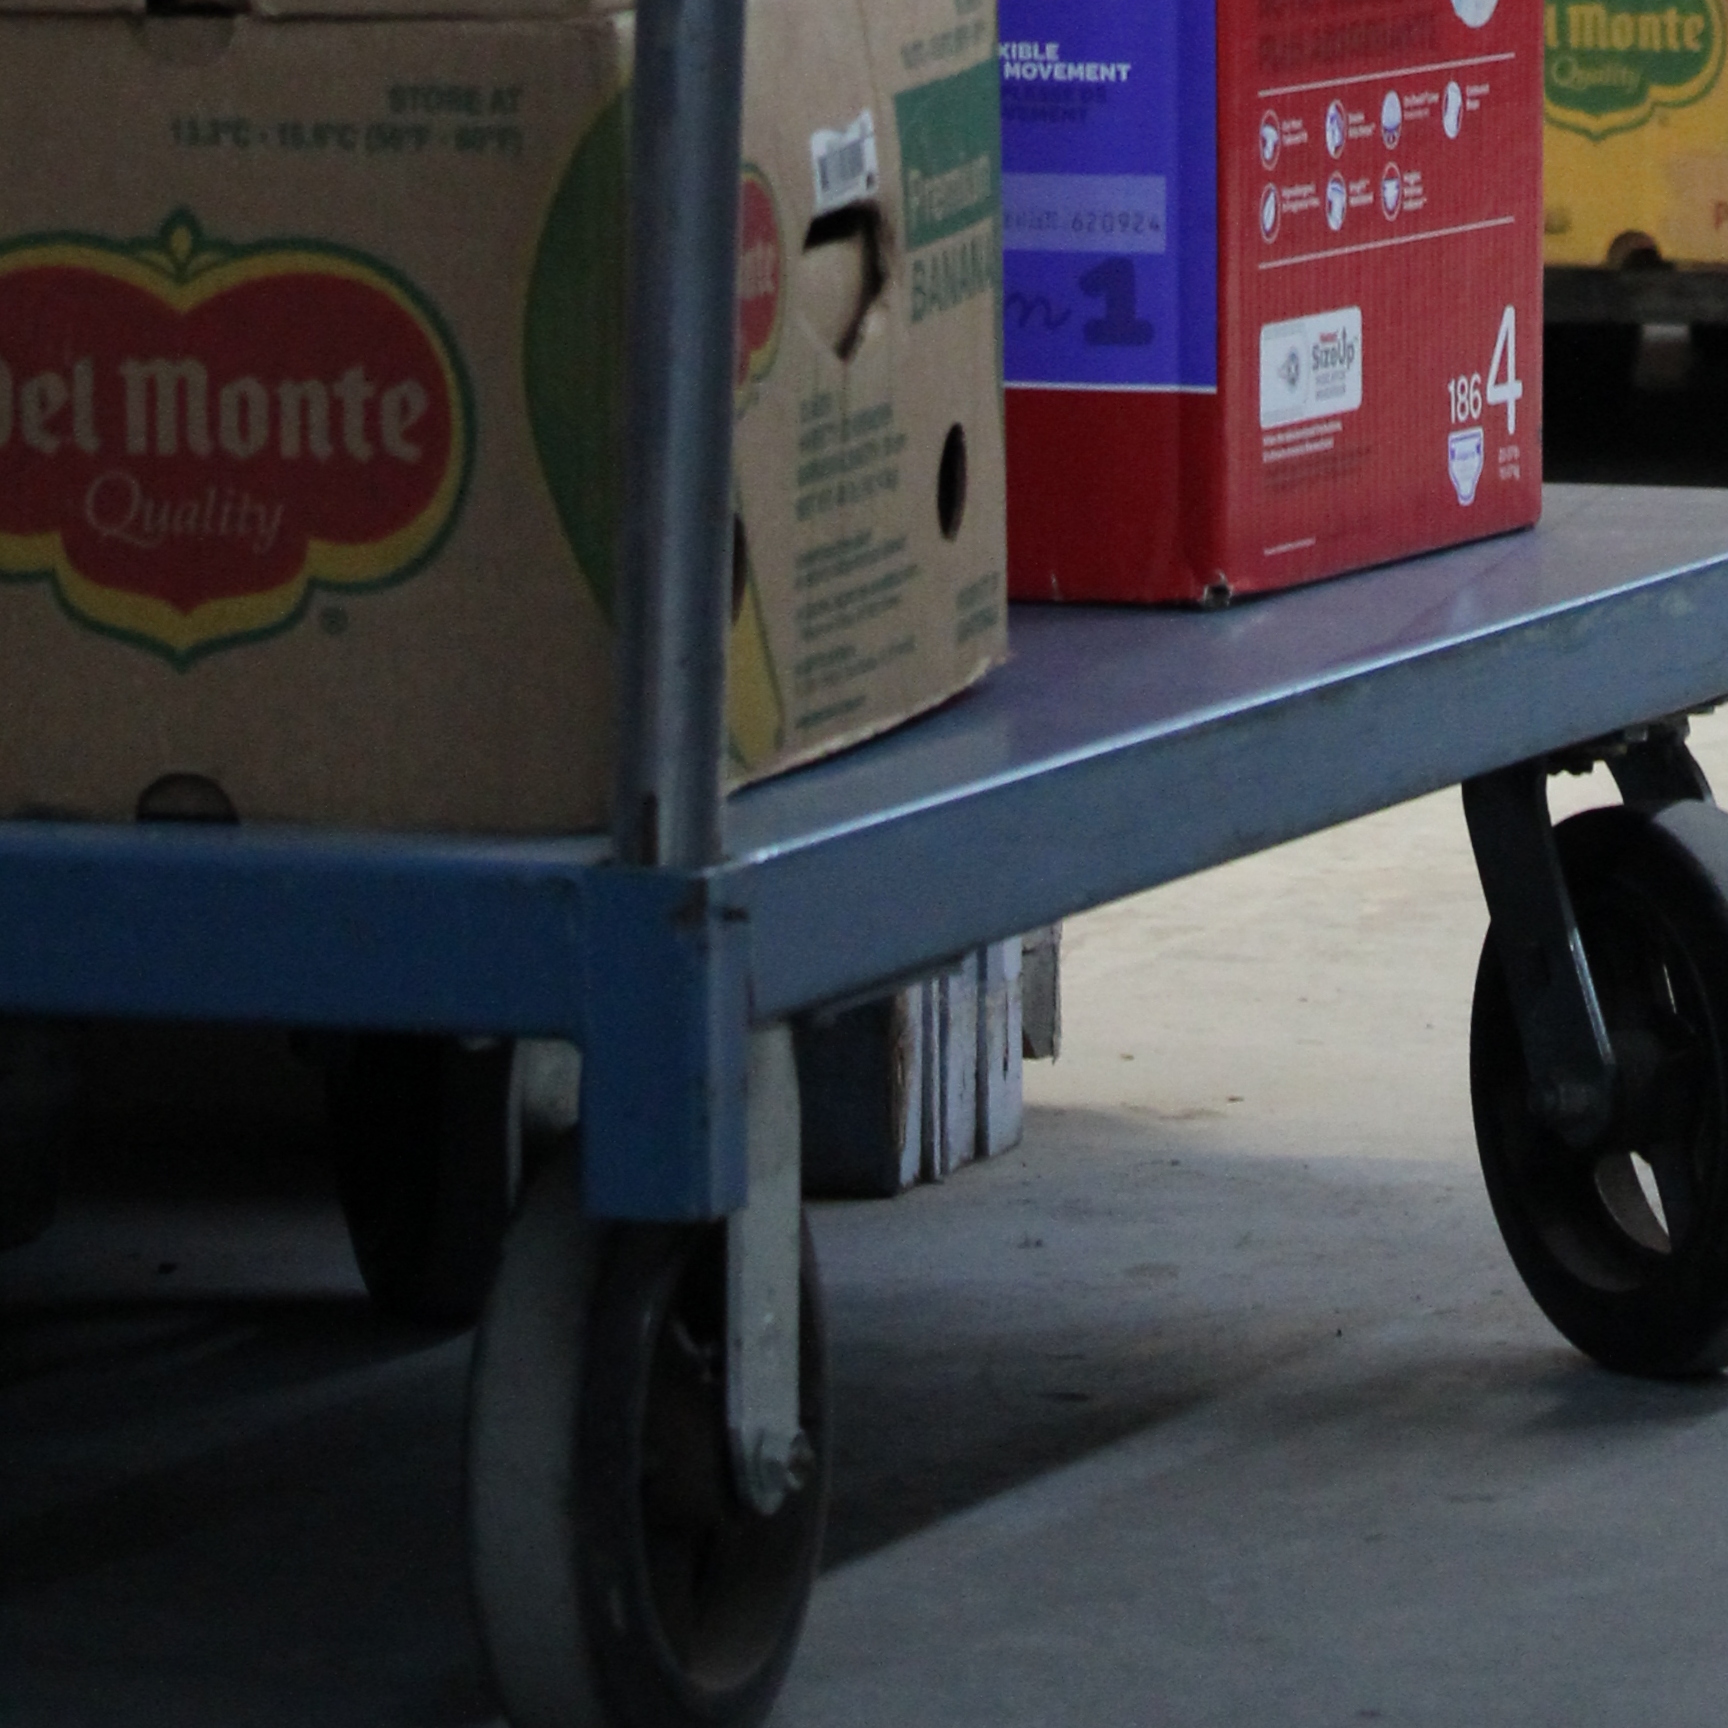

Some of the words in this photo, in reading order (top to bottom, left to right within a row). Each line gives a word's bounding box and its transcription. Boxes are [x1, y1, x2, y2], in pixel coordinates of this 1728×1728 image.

[1004, 62, 1132, 82] MOVEMENT
[1567, 3, 1706, 54] Monte
[120, 356, 432, 464] Monte
[1447, 371, 1483, 425] 186
[1486, 303, 1524, 436] 4
[82, 464, 288, 555] Quality
